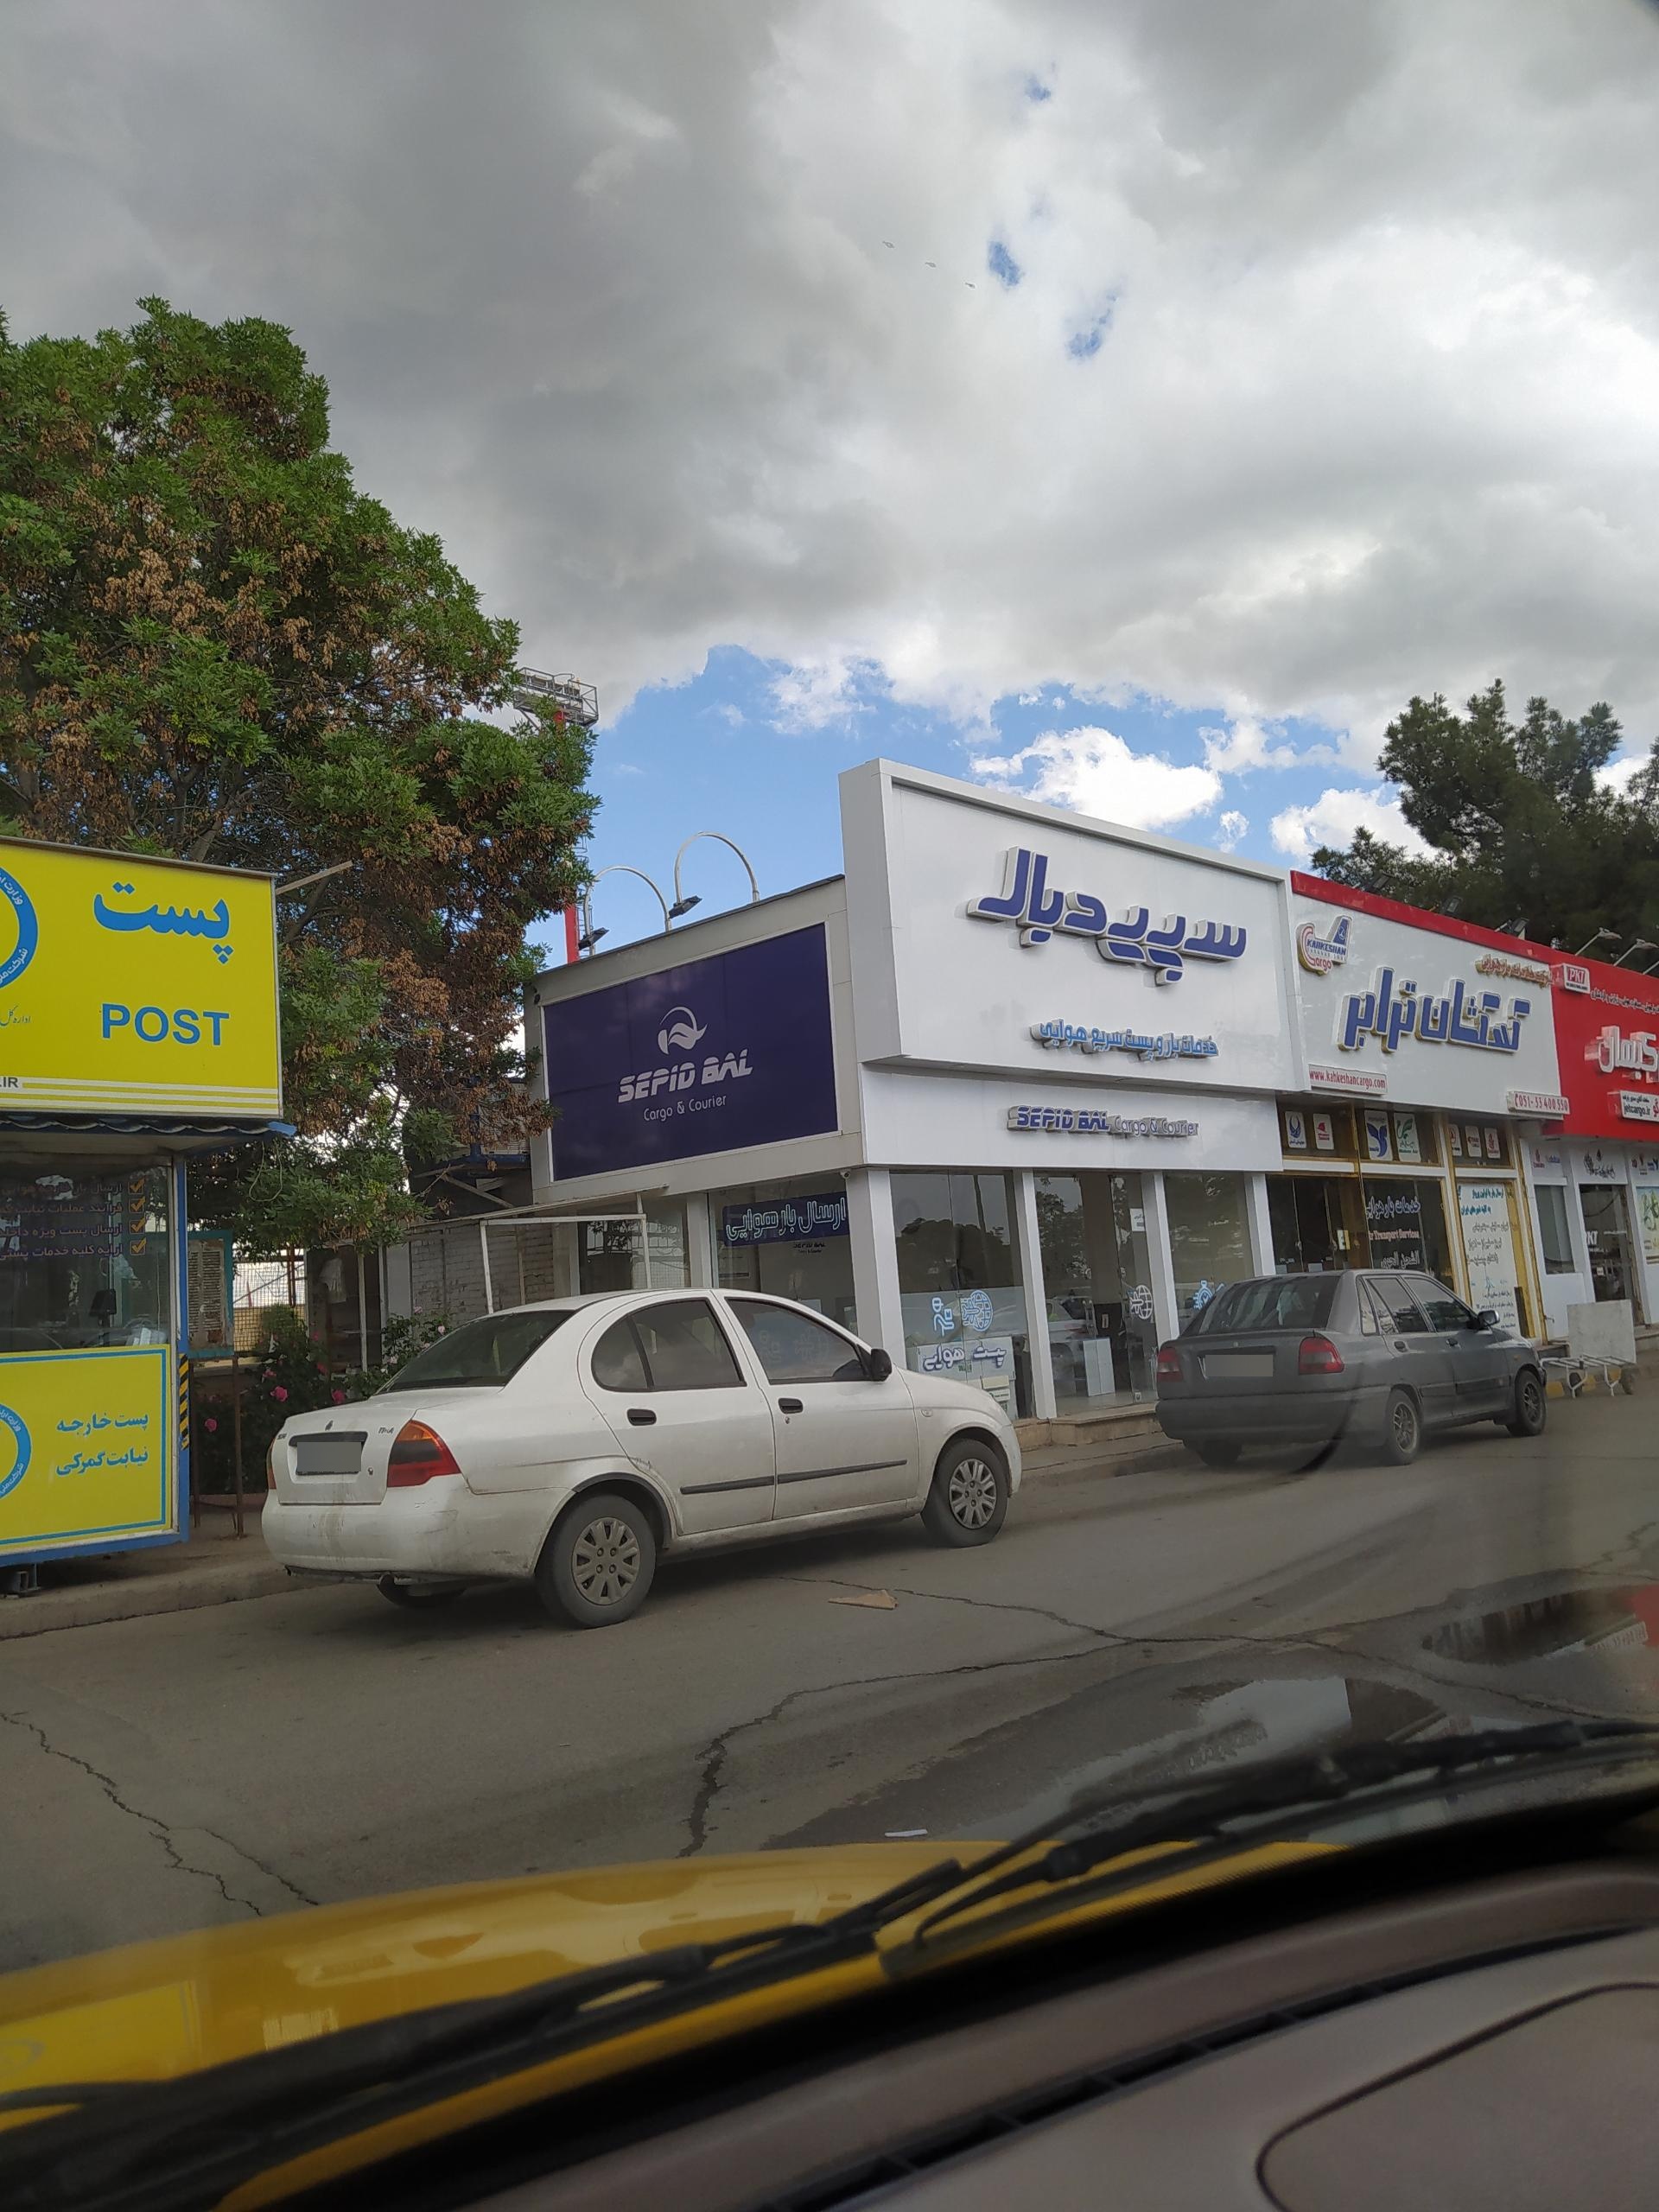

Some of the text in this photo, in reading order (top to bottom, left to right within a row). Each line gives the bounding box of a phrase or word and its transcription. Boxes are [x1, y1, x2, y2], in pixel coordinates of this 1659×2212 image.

[92, 880, 233, 965] پست
[1568, 967, 1586, 985] PKT
[100, 1003, 231, 1046] POST
[1039, 1018, 1219, 1061] خدمات بار و پست سریع هوایی
[618, 1048, 753, 1103] SEPID BAL
[644, 1096, 727, 1121] Cargo & Courier
[1016, 1105, 1199, 1137] SEPID BAL Cargo & Courier
[726, 1197, 847, 1241] ارسال بار هوایی
[924, 1344, 1007, 1371] پست هوایی
[56, 1412, 149, 1436] پست خارجه
[106, 1446, 149, 1468] نیابت
